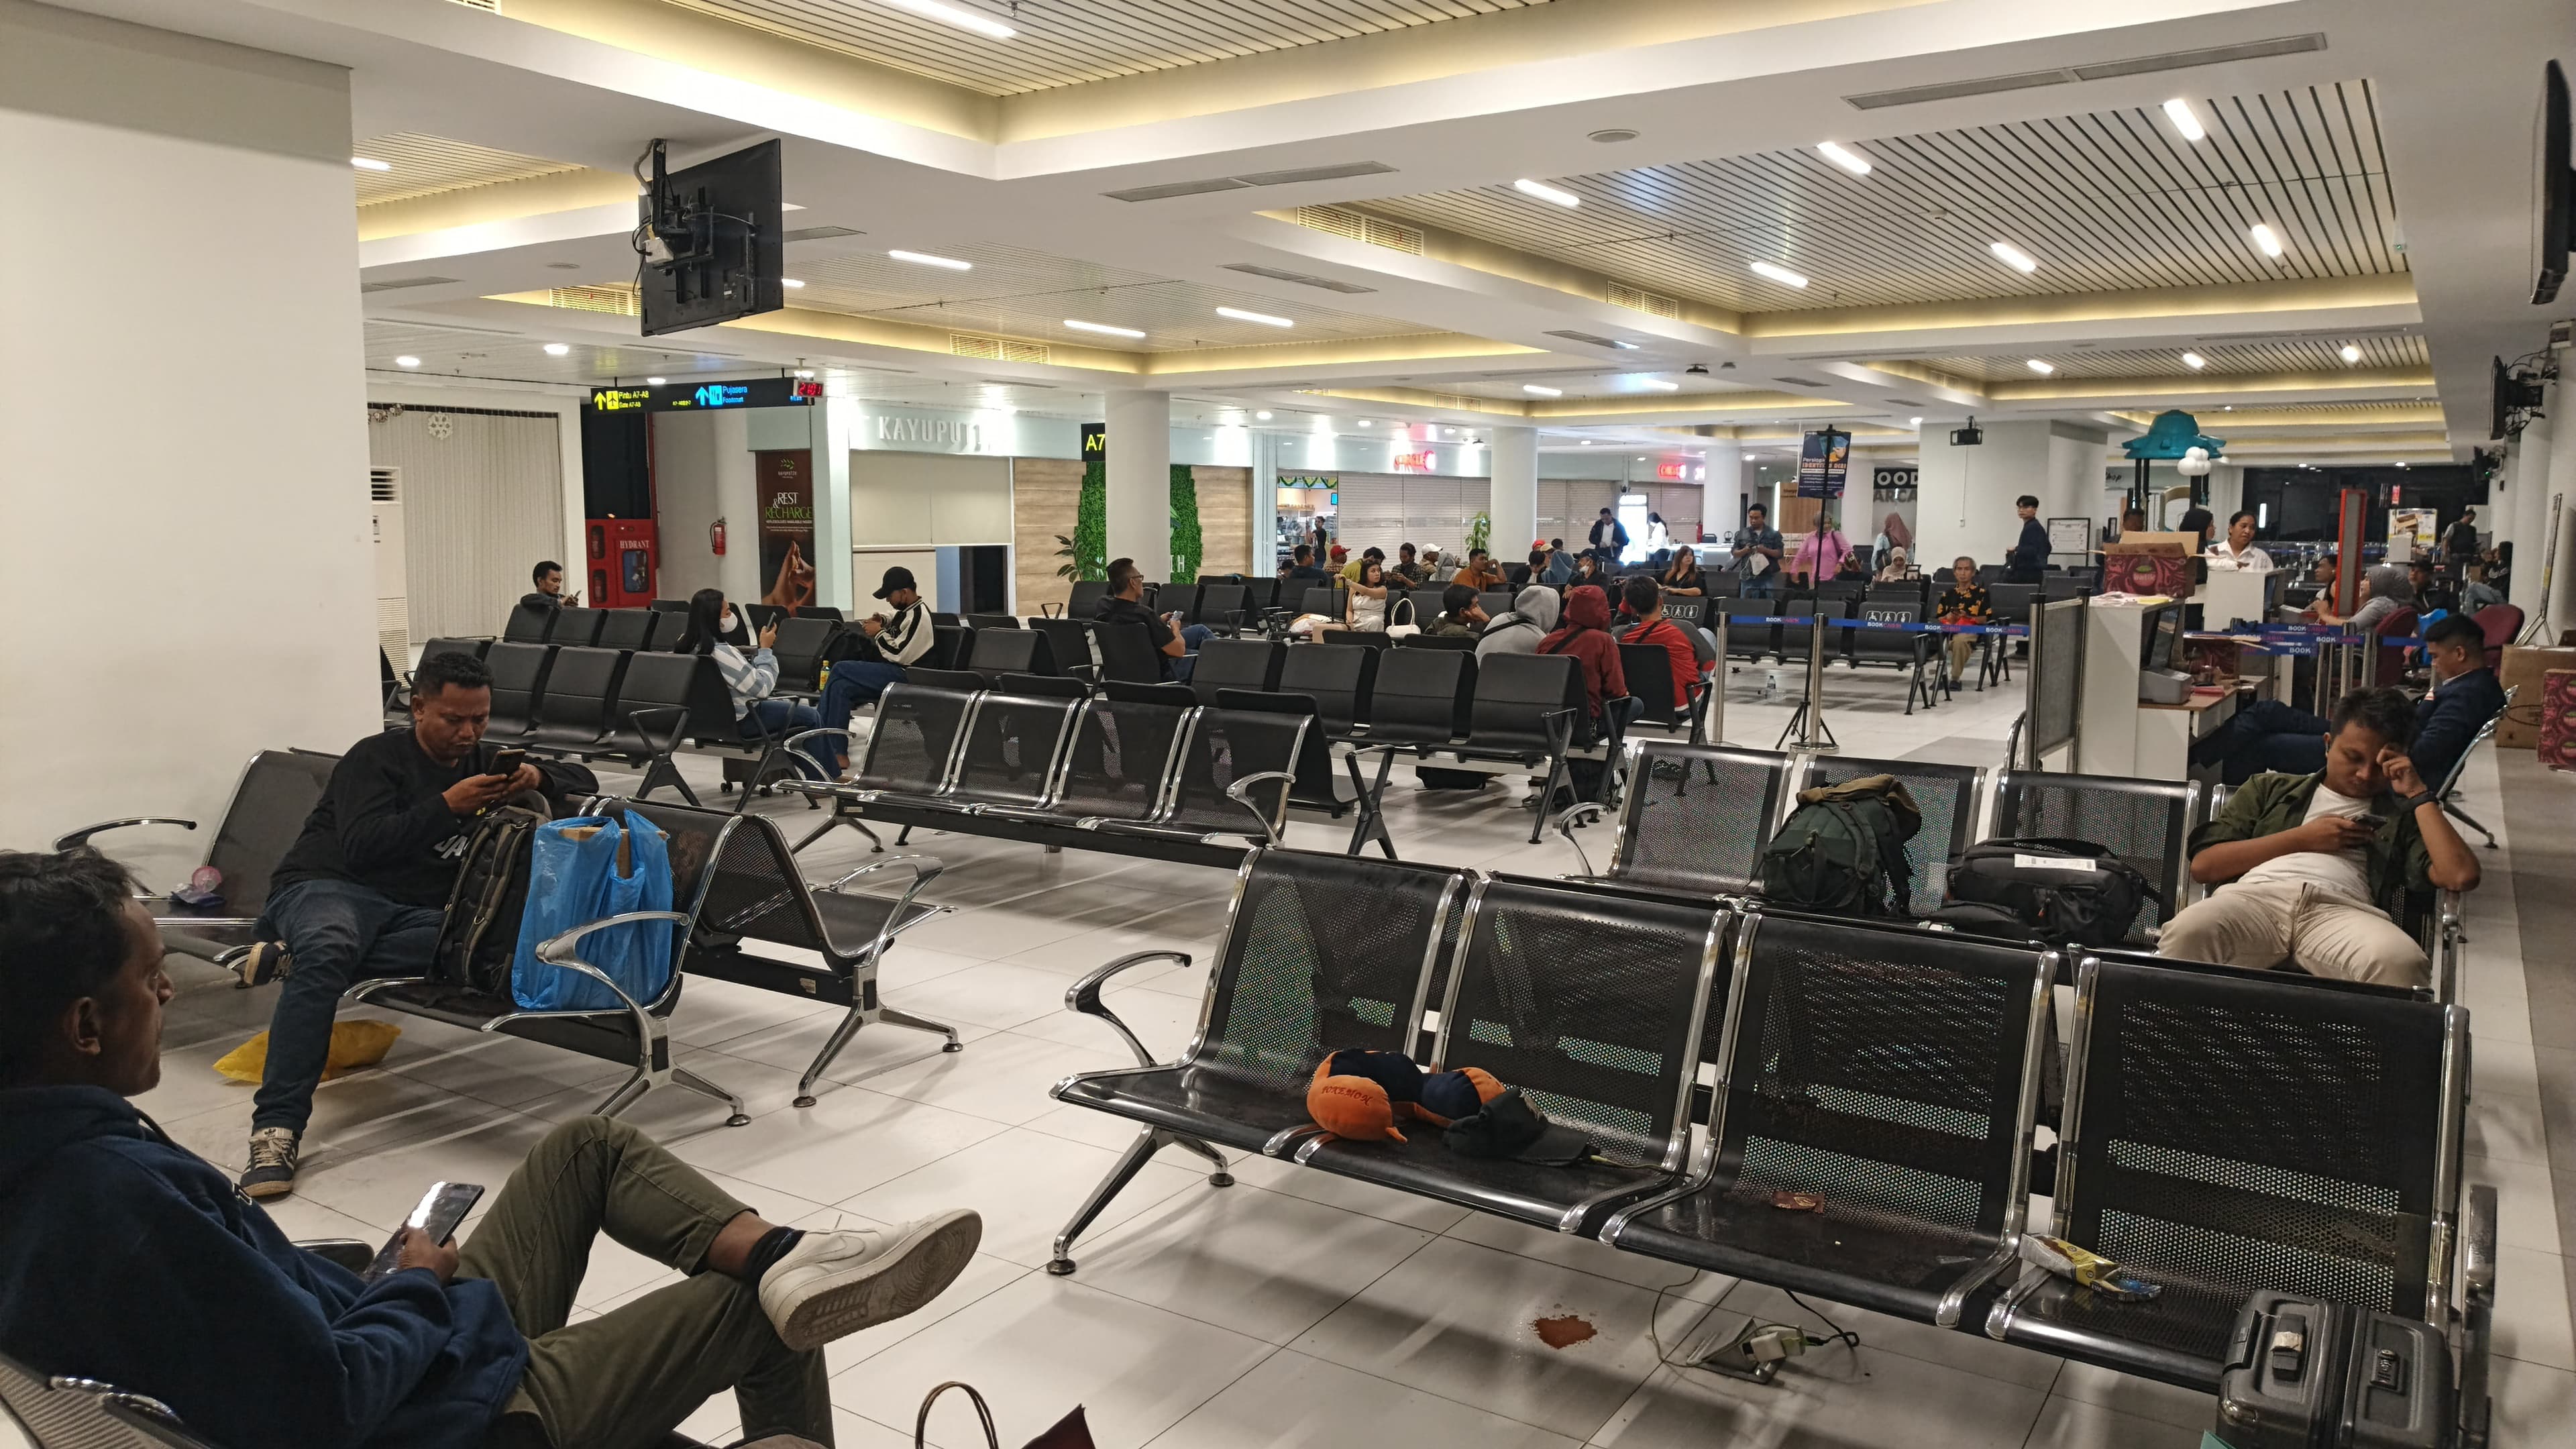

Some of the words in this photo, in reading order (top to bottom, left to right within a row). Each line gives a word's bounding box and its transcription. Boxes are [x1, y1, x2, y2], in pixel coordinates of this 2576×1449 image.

[619, 391, 631, 399] Pintu
[1085, 433, 1106, 451] A7
[1876, 471, 1918, 486] OOD
[777, 492, 799, 505] REST
[765, 506, 813, 519] RECHARGE
[620, 540, 649, 549] HYDRANT
